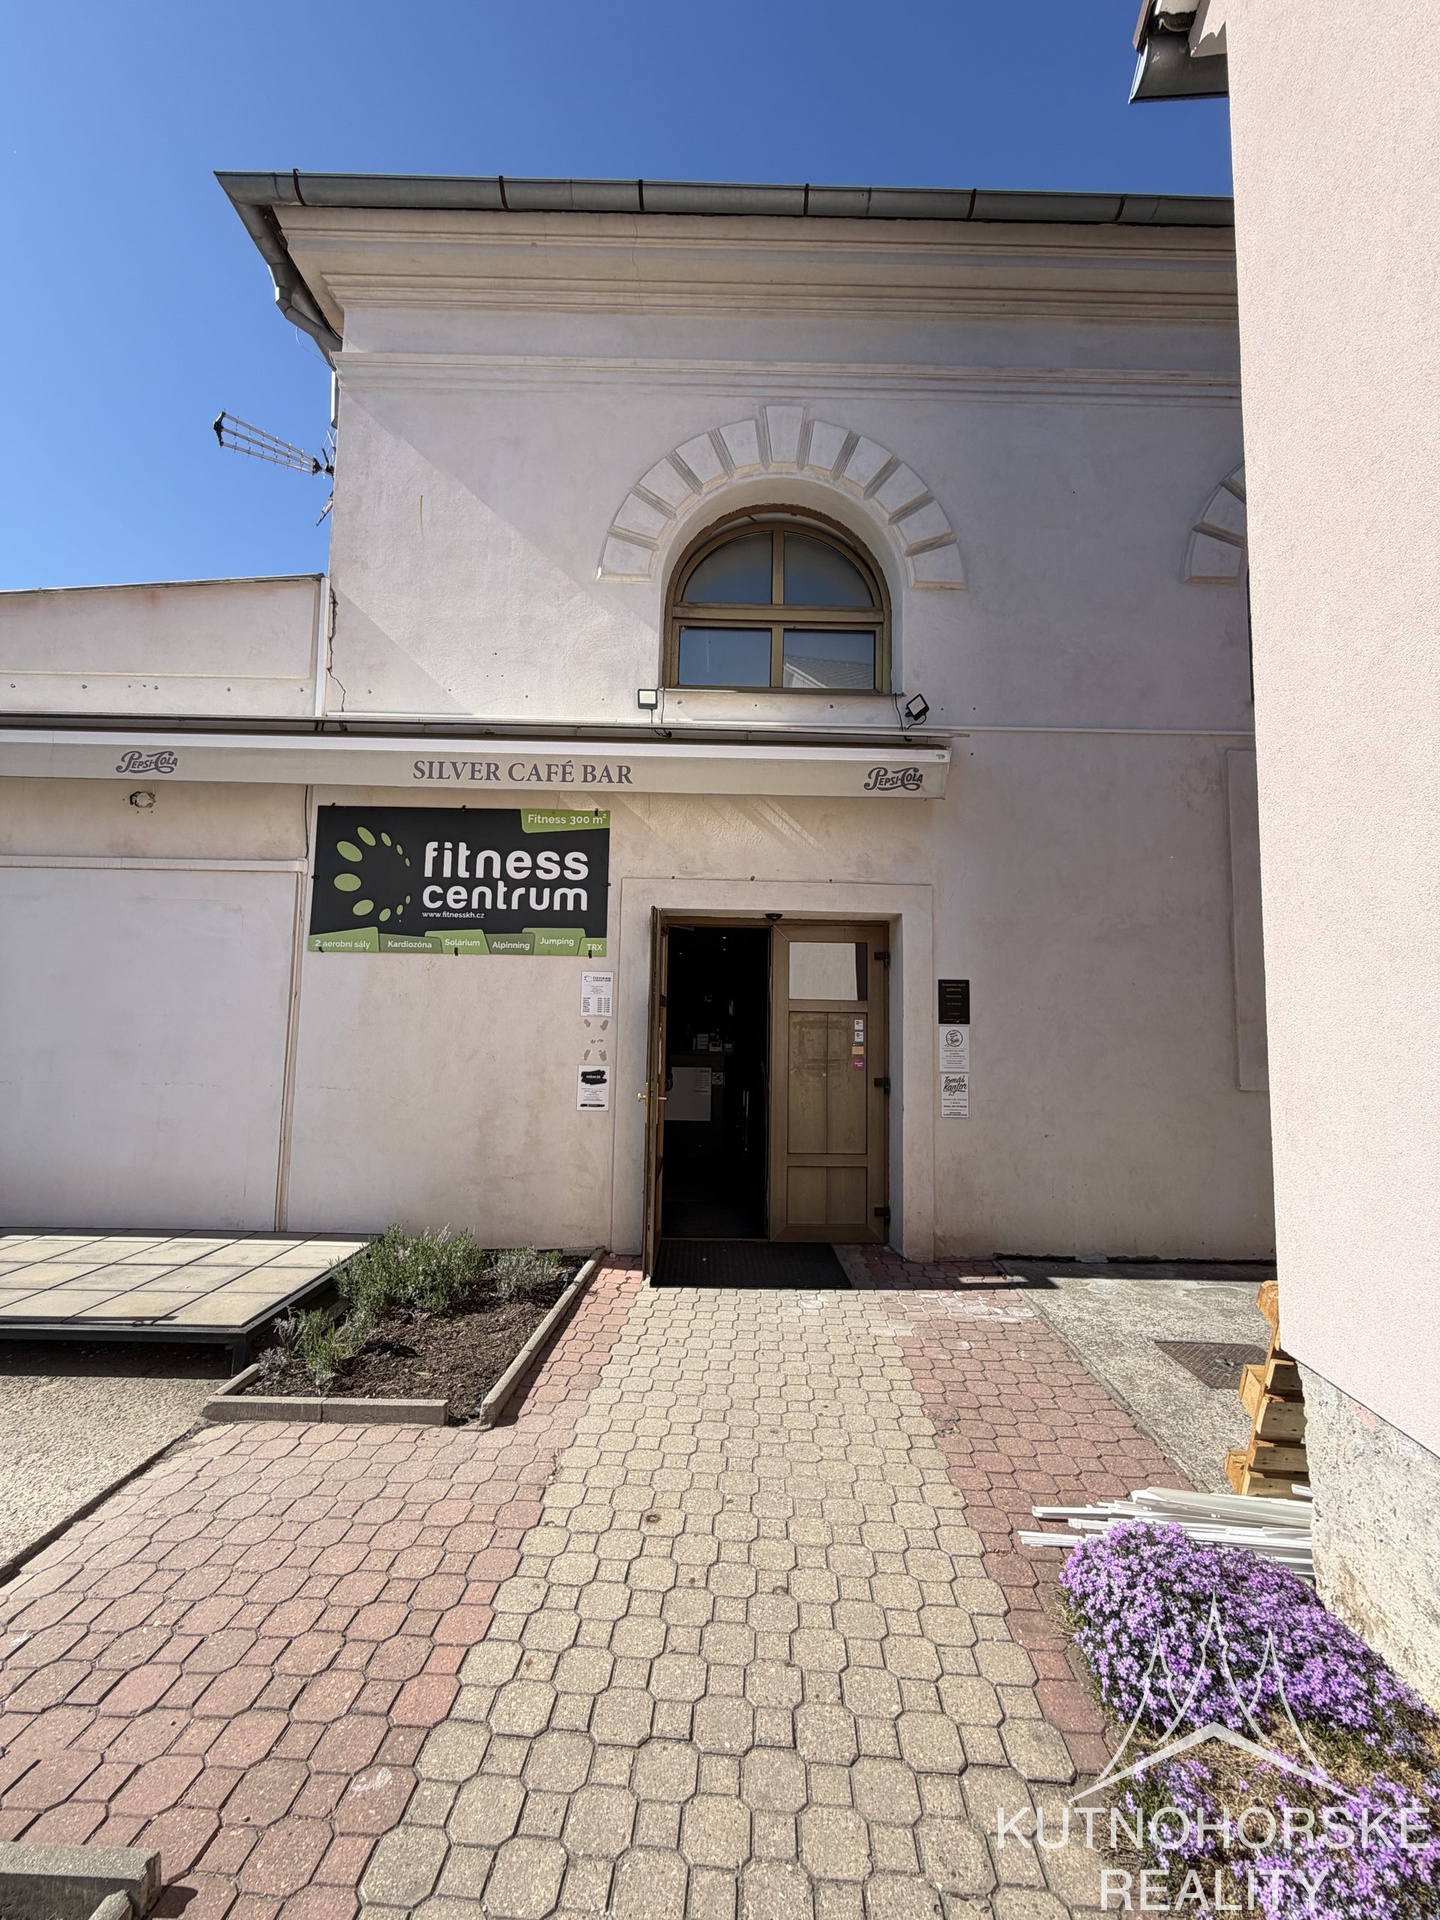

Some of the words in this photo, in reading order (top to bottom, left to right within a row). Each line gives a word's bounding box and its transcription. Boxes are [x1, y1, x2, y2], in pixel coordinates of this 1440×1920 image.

[413, 760, 501, 781] SILVER
[508, 760, 575, 783] CAFÉ
[581, 764, 633, 784] BAR
[527, 814, 567, 824] Fitness
[569, 816, 590, 825] 300
[424, 841, 589, 881] fitness
[422, 880, 588, 911] centrum
[422, 911, 485, 919] www.fitnesskh.cz
[314, 939, 321, 947] 2
[322, 940, 353, 948] aerobní
[354, 939, 371, 949] sály
[387, 940, 432, 949] Kardiozóna
[444, 938, 480, 947] Solárium
[492, 941, 530, 951] Alpinning
[539, 937, 575, 947] Jumping
[586, 943, 603, 951] TRX
